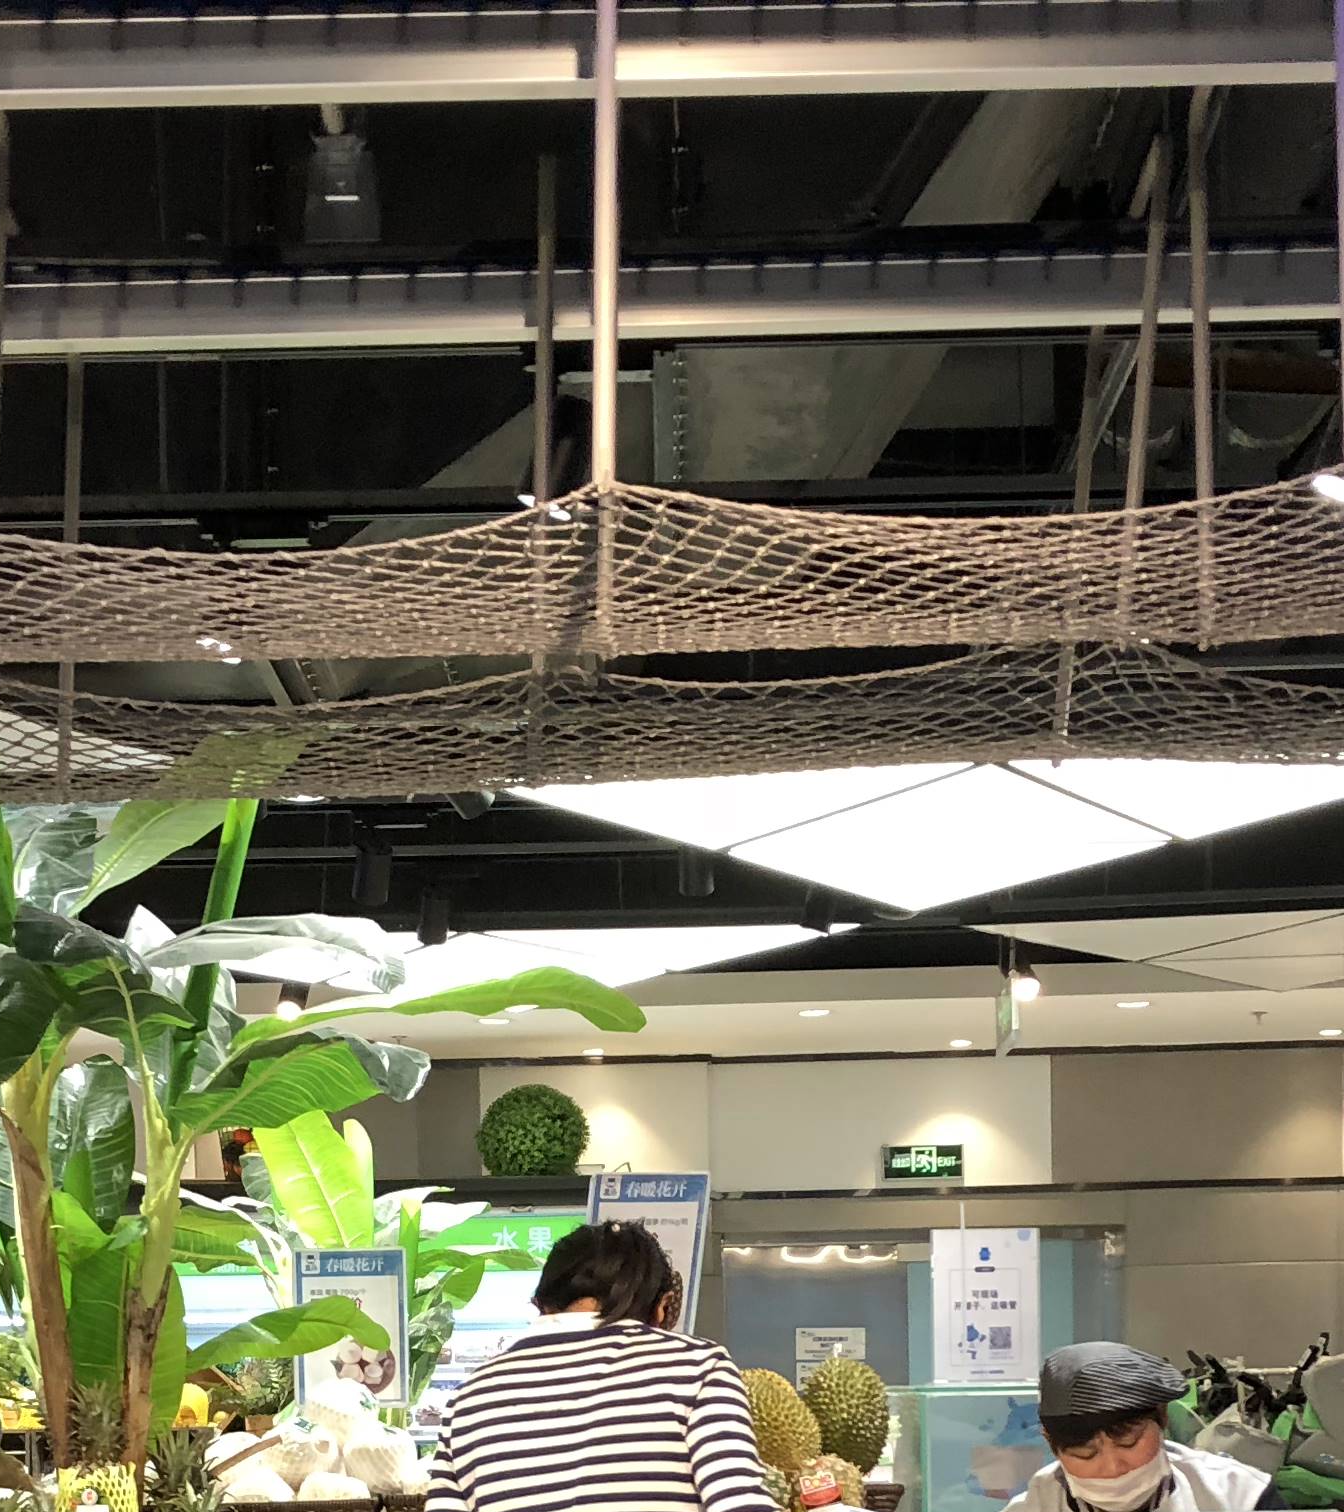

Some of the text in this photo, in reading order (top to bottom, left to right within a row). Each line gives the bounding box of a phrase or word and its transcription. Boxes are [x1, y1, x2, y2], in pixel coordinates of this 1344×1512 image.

[937, 1156, 956, 1167] EXIT
[626, 1181, 688, 1198] 春暖花开
[492, 1226, 552, 1251] 水果
[326, 1257, 384, 1272] 春暖花开
[802, 1474, 831, 1487] Dole
